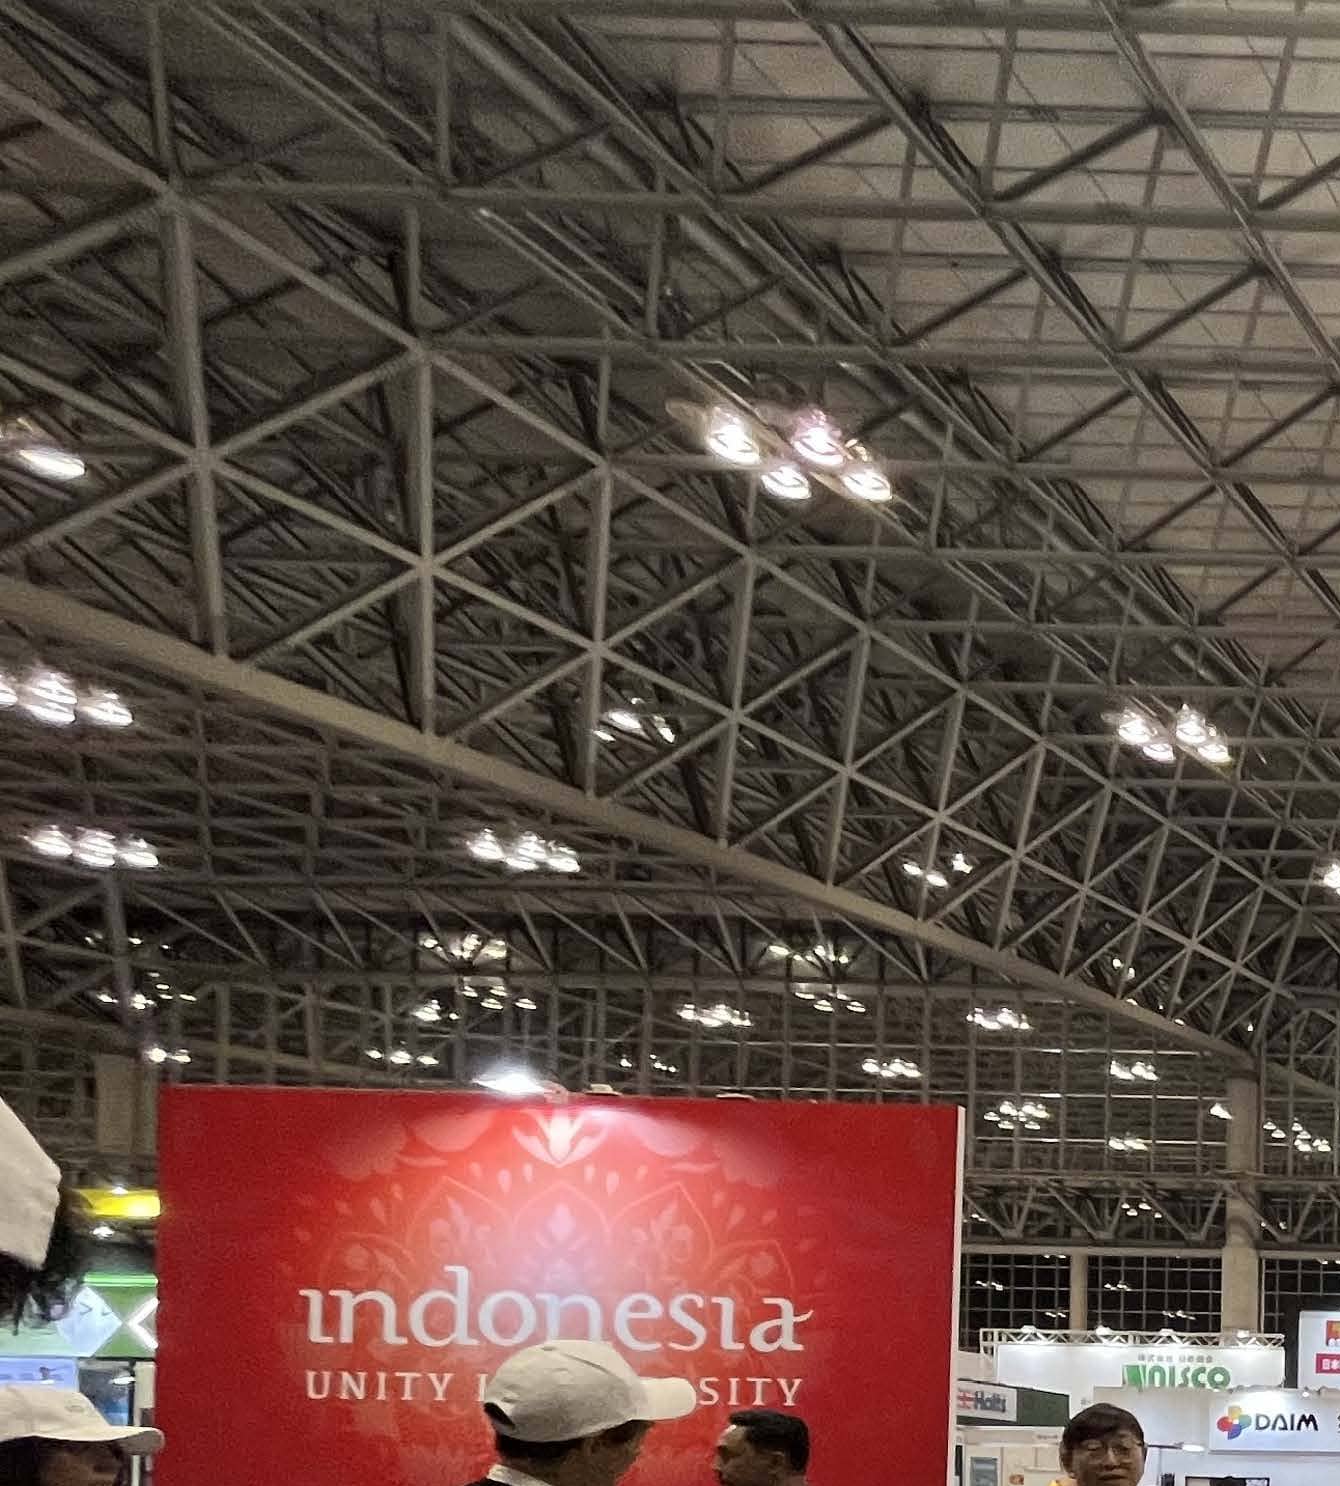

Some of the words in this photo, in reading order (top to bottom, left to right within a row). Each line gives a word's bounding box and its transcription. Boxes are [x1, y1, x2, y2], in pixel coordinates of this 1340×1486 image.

[299, 1265, 813, 1352] indonesia
[306, 1371, 454, 1402] UNITY
[1255, 1413, 1319, 1432] DAIM
